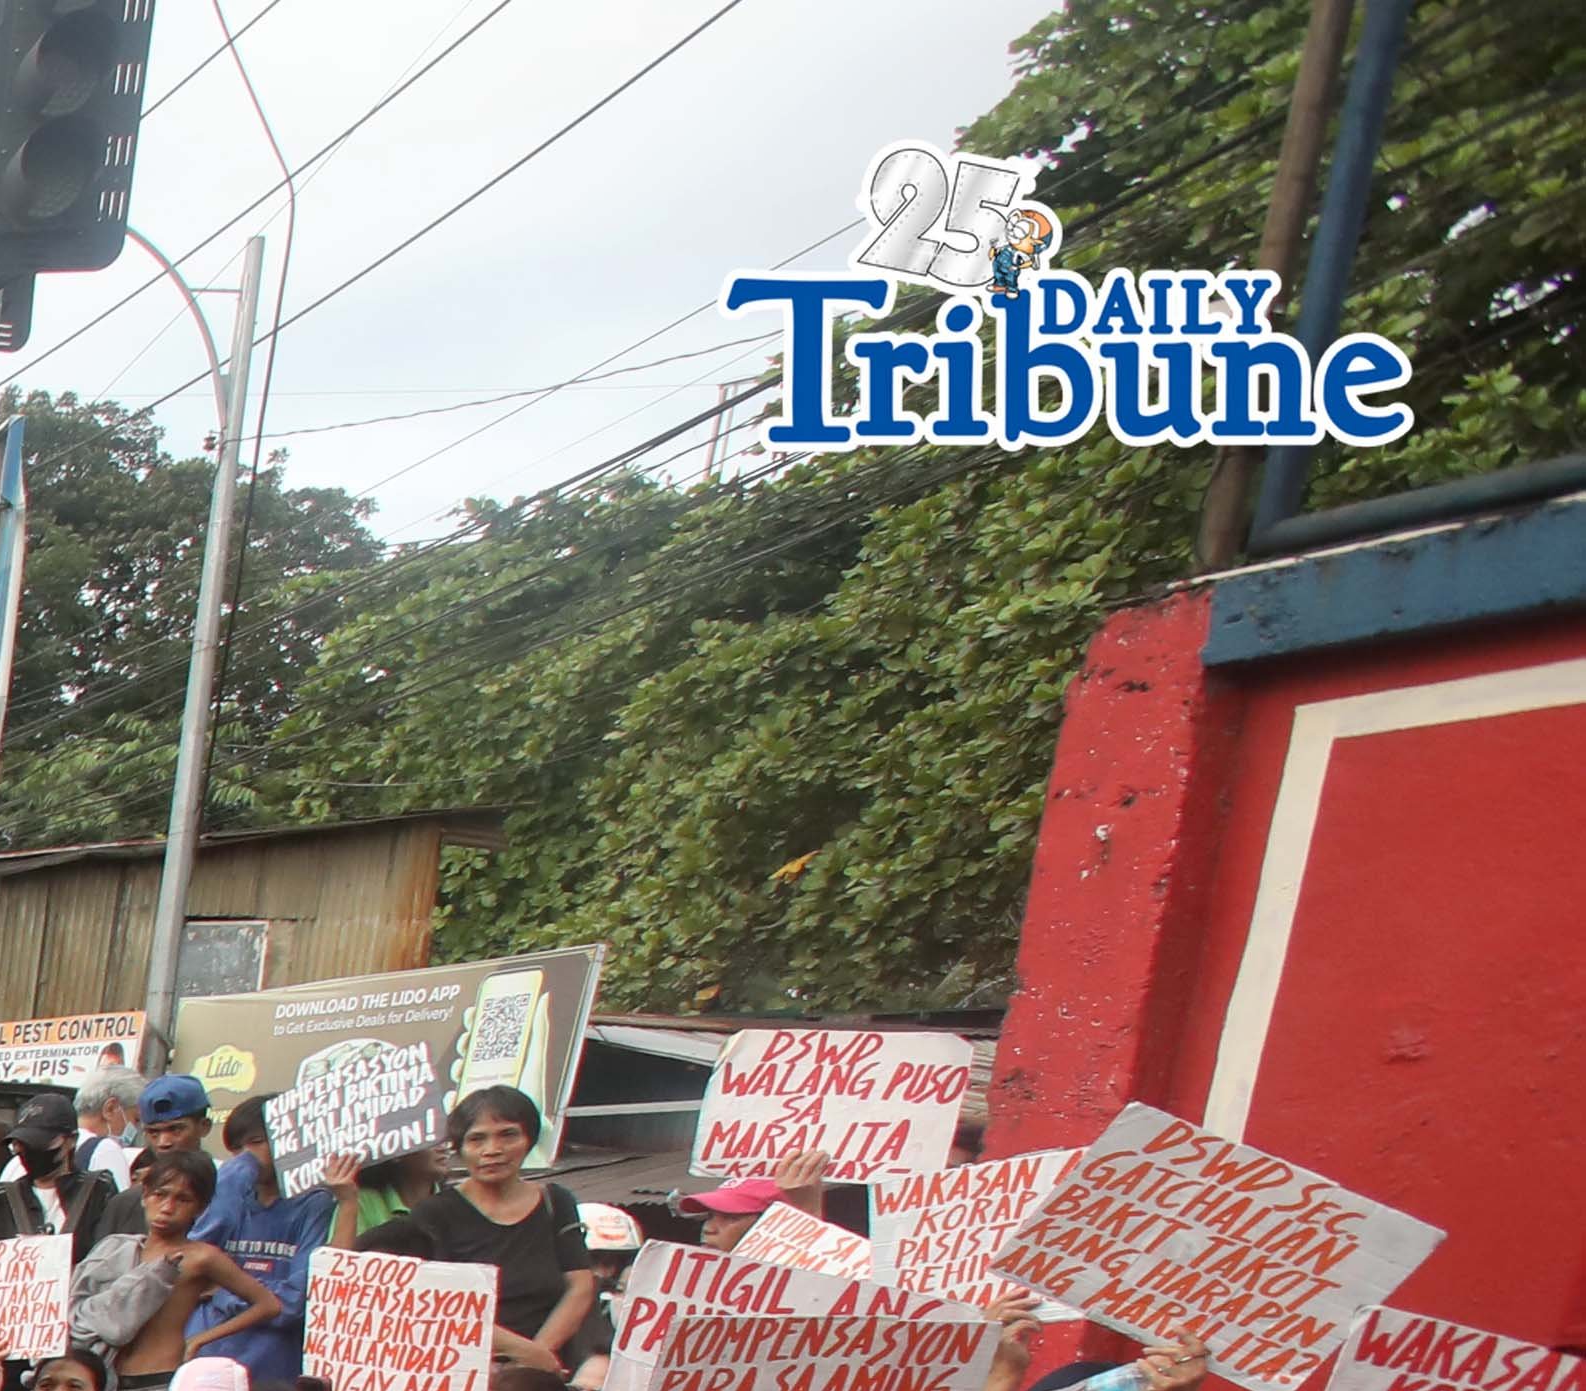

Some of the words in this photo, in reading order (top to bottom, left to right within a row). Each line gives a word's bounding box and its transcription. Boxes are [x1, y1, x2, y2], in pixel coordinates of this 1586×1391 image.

[274, 1025, 284, 1035] to
[286, 1020, 304, 1035] Get
[307, 1016, 354, 1032] Exclusive
[356, 1014, 385, 1028] Deals
[387, 1011, 403, 1025] for
[405, 1006, 454, 1024] Delivery!
[275, 999, 359, 1020] DOWNLOAD
[362, 993, 389, 1009] THE
[391, 990, 424, 1007] LIDO
[428, 984, 460, 1002] APP
[12, 1022, 52, 1044] PEST
[57, 1017, 137, 1041] CONTROL
[761, 1031, 883, 1066] DSWD
[14, 1046, 99, 1061] EXTERMINATOR
[32, 1059, 70, 1076] IPIS
[205, 1054, 240, 1079] Lido
[265, 1041, 428, 1123] KUMPENSASYON
[271, 1115, 292, 1139] SA
[298, 1090, 340, 1127] MGA
[345, 1062, 436, 1103] BIKTIMA
[721, 1062, 880, 1100] WALANG
[881, 1062, 970, 1104] PUSO
[274, 1131, 299, 1159] NG
[302, 1086, 425, 1147] KALAMIDAD
[774, 1095, 824, 1125] SA
[1143, 1121, 1295, 1192] DSWD
[875, 1158, 1042, 1217] WAKASAN
[914, 1191, 1037, 1236] KORAP
[1082, 1150, 1359, 1277] GATCHALIAN
[1043, 1183, 1191, 1255] BAKIT
[1188, 1236, 1341, 1311] TAKOT
[330, 1253, 418, 1286] 25,000
[660, 1248, 796, 1315] ITIGIL
[991, 1244, 1086, 1294] ANG
[1020, 1218, 1137, 1277] KANG
[1139, 1259, 1337, 1349] HARAPIN
[308, 1275, 488, 1318] KUMPENSASYON
[308, 1305, 327, 1328] SA
[334, 1306, 372, 1337] MGA
[377, 1314, 484, 1346] BIKTIMA
[664, 1314, 987, 1369] KOMPENSASYON
[305, 1335, 326, 1357] NG
[331, 1339, 460, 1373] KALAMIDAD
